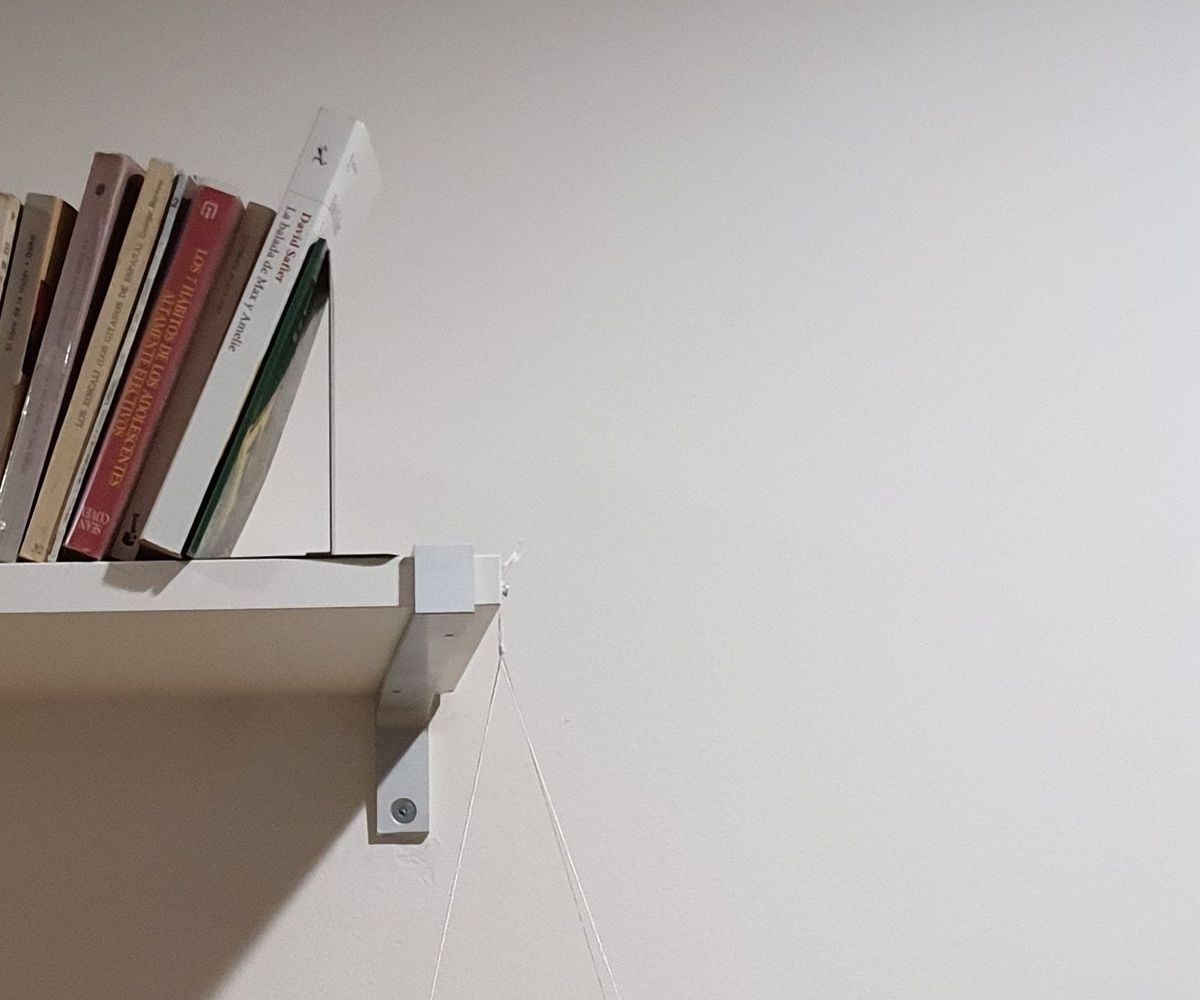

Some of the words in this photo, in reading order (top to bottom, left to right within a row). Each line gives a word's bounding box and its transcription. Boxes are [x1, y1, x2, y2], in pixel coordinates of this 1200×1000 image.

[281, 204, 297, 222] La
[265, 220, 291, 260] balada
[287, 211, 312, 249] David
[187, 247, 207, 274] LOS
[258, 259, 274, 276] de
[273, 248, 297, 284] Safier
[183, 273, 198, 285] 7
[247, 275, 268, 304] Max
[102, 300, 125, 343] GITANOS
[117, 283, 130, 299] DE
[241, 300, 254, 312] y
[136, 287, 175, 368] ALTAMENTE
[226, 310, 253, 354] Amelie
[154, 342, 172, 363] DE
[144, 362, 164, 389] LOS
[111, 366, 148, 440] EFECTIVOS
[107, 389, 155, 489] ADOLESCENTES
